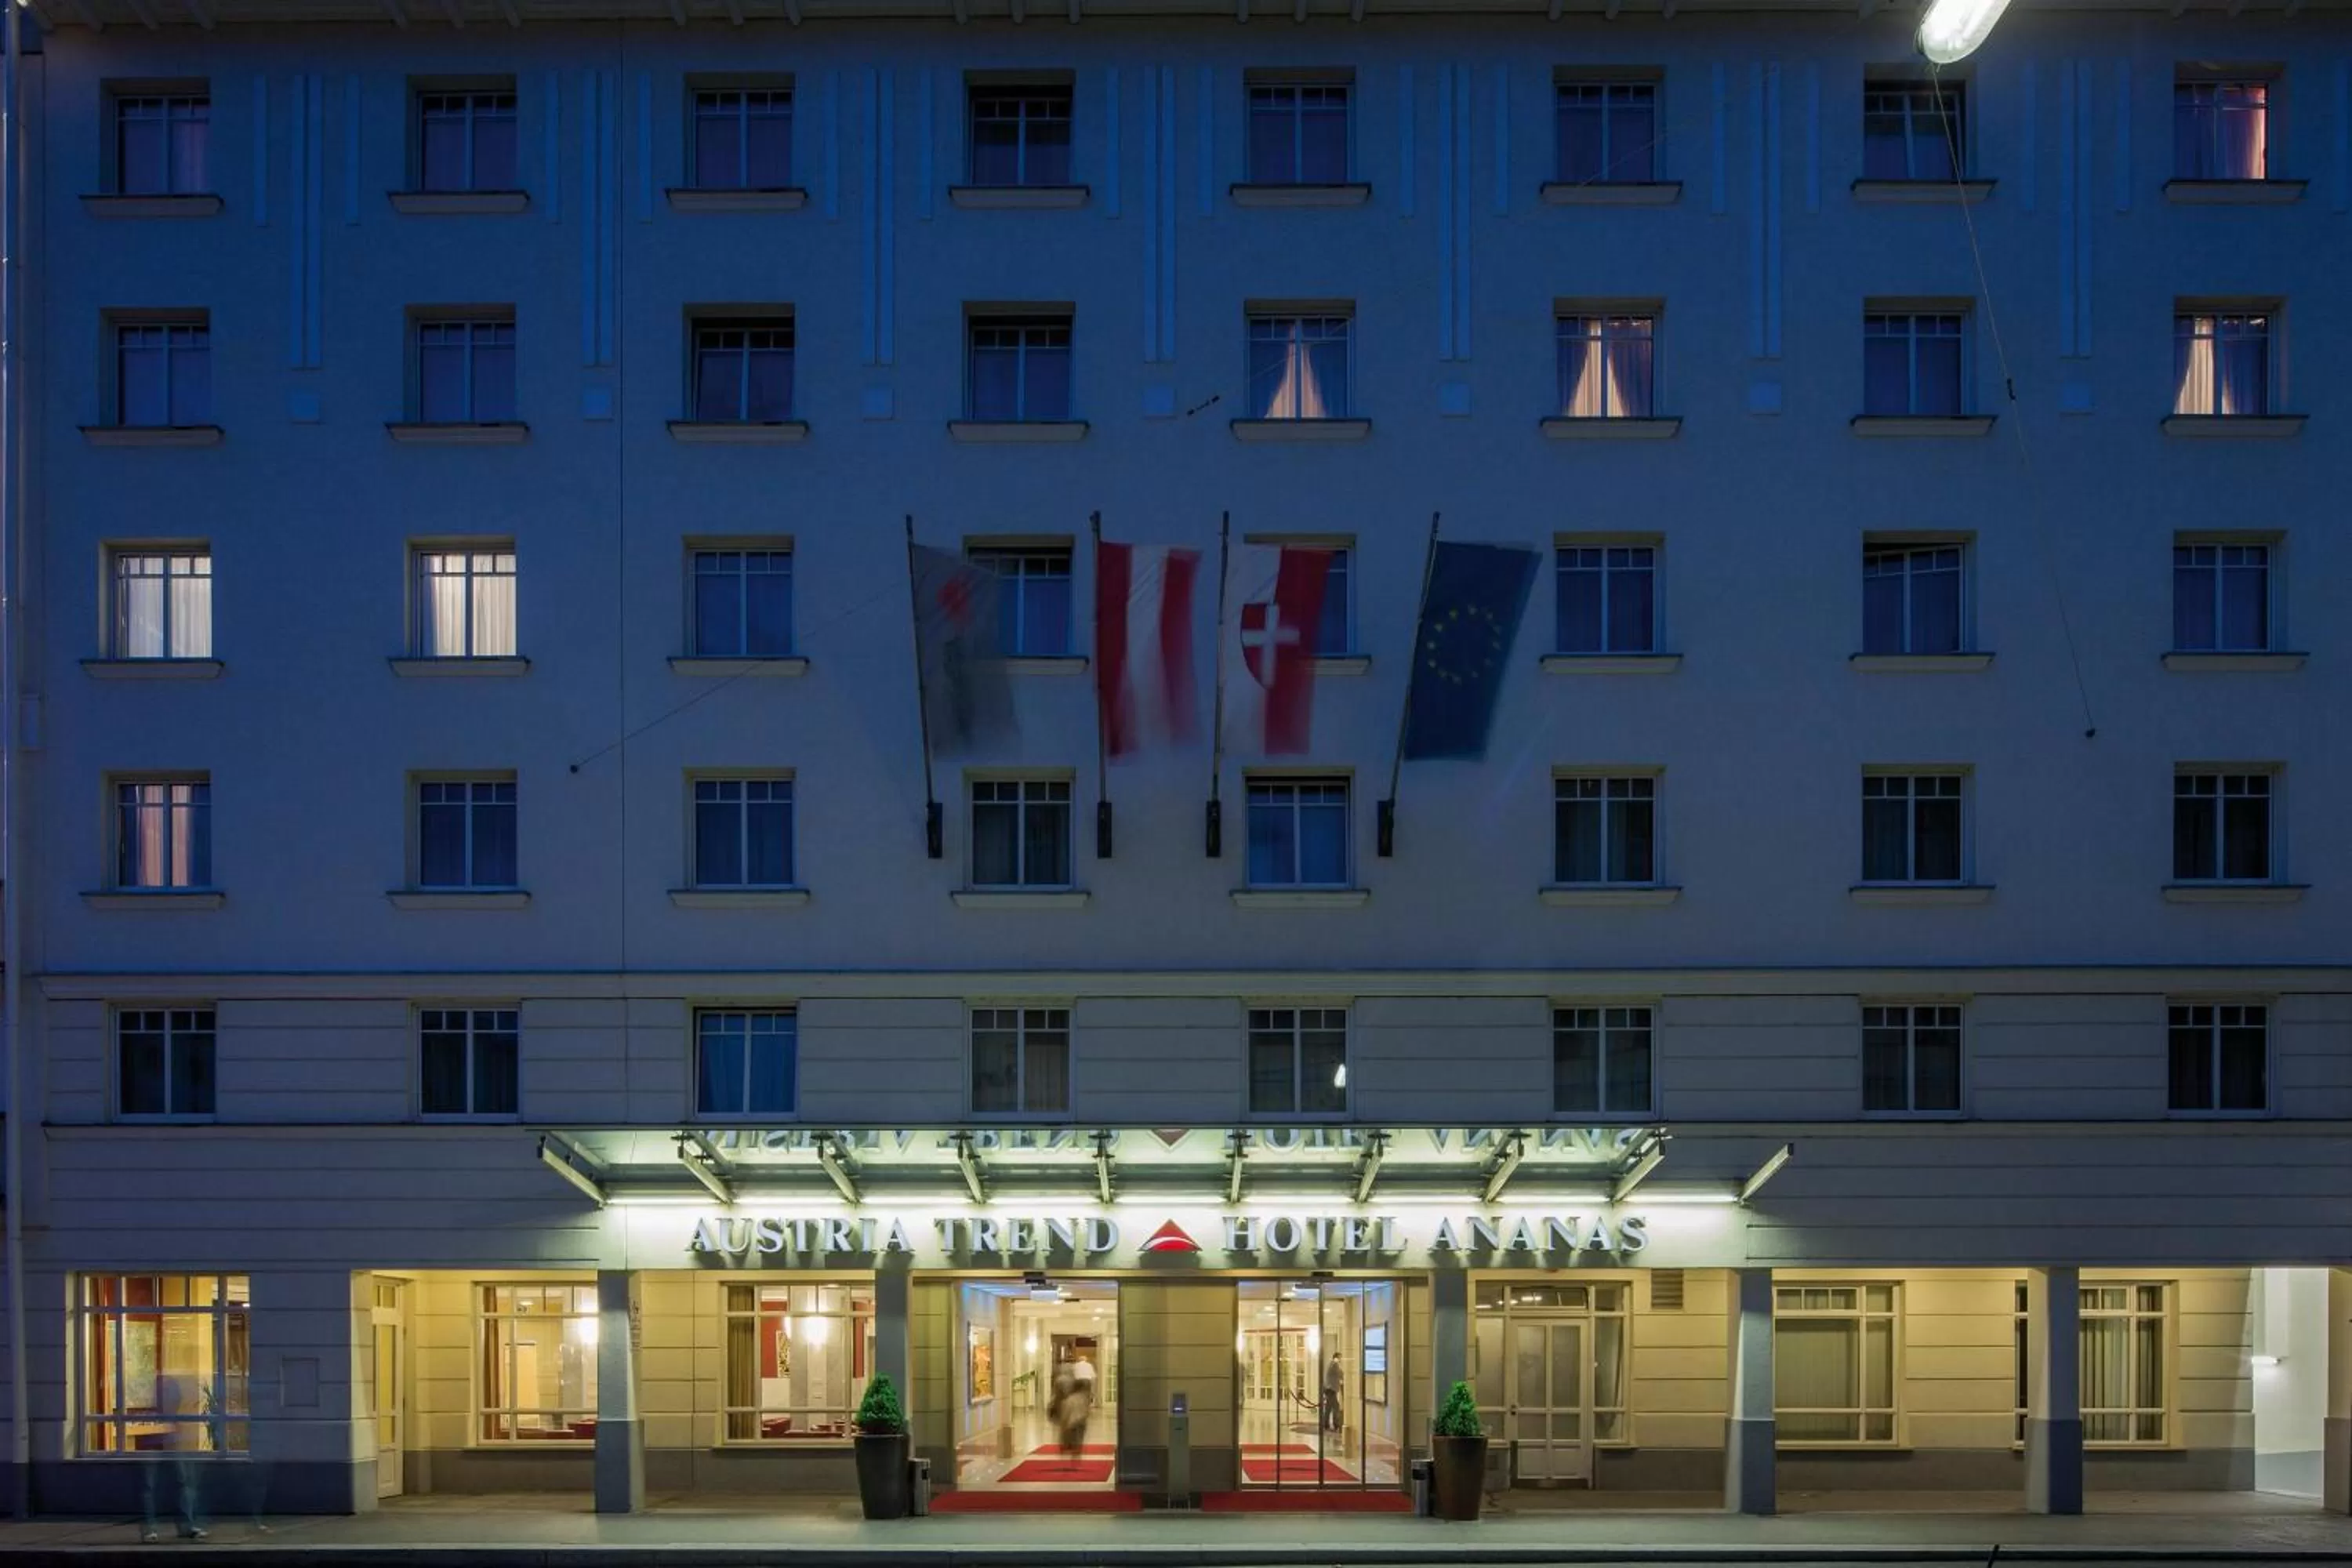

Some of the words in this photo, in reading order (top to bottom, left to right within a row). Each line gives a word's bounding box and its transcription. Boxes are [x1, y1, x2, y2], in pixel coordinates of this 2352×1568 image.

[685, 1217, 916, 1253] AUSTRIA
[934, 1217, 1120, 1253] TREND
[1221, 1216, 1408, 1253] HOTEL
[1427, 1216, 1649, 1252] ANANAS
